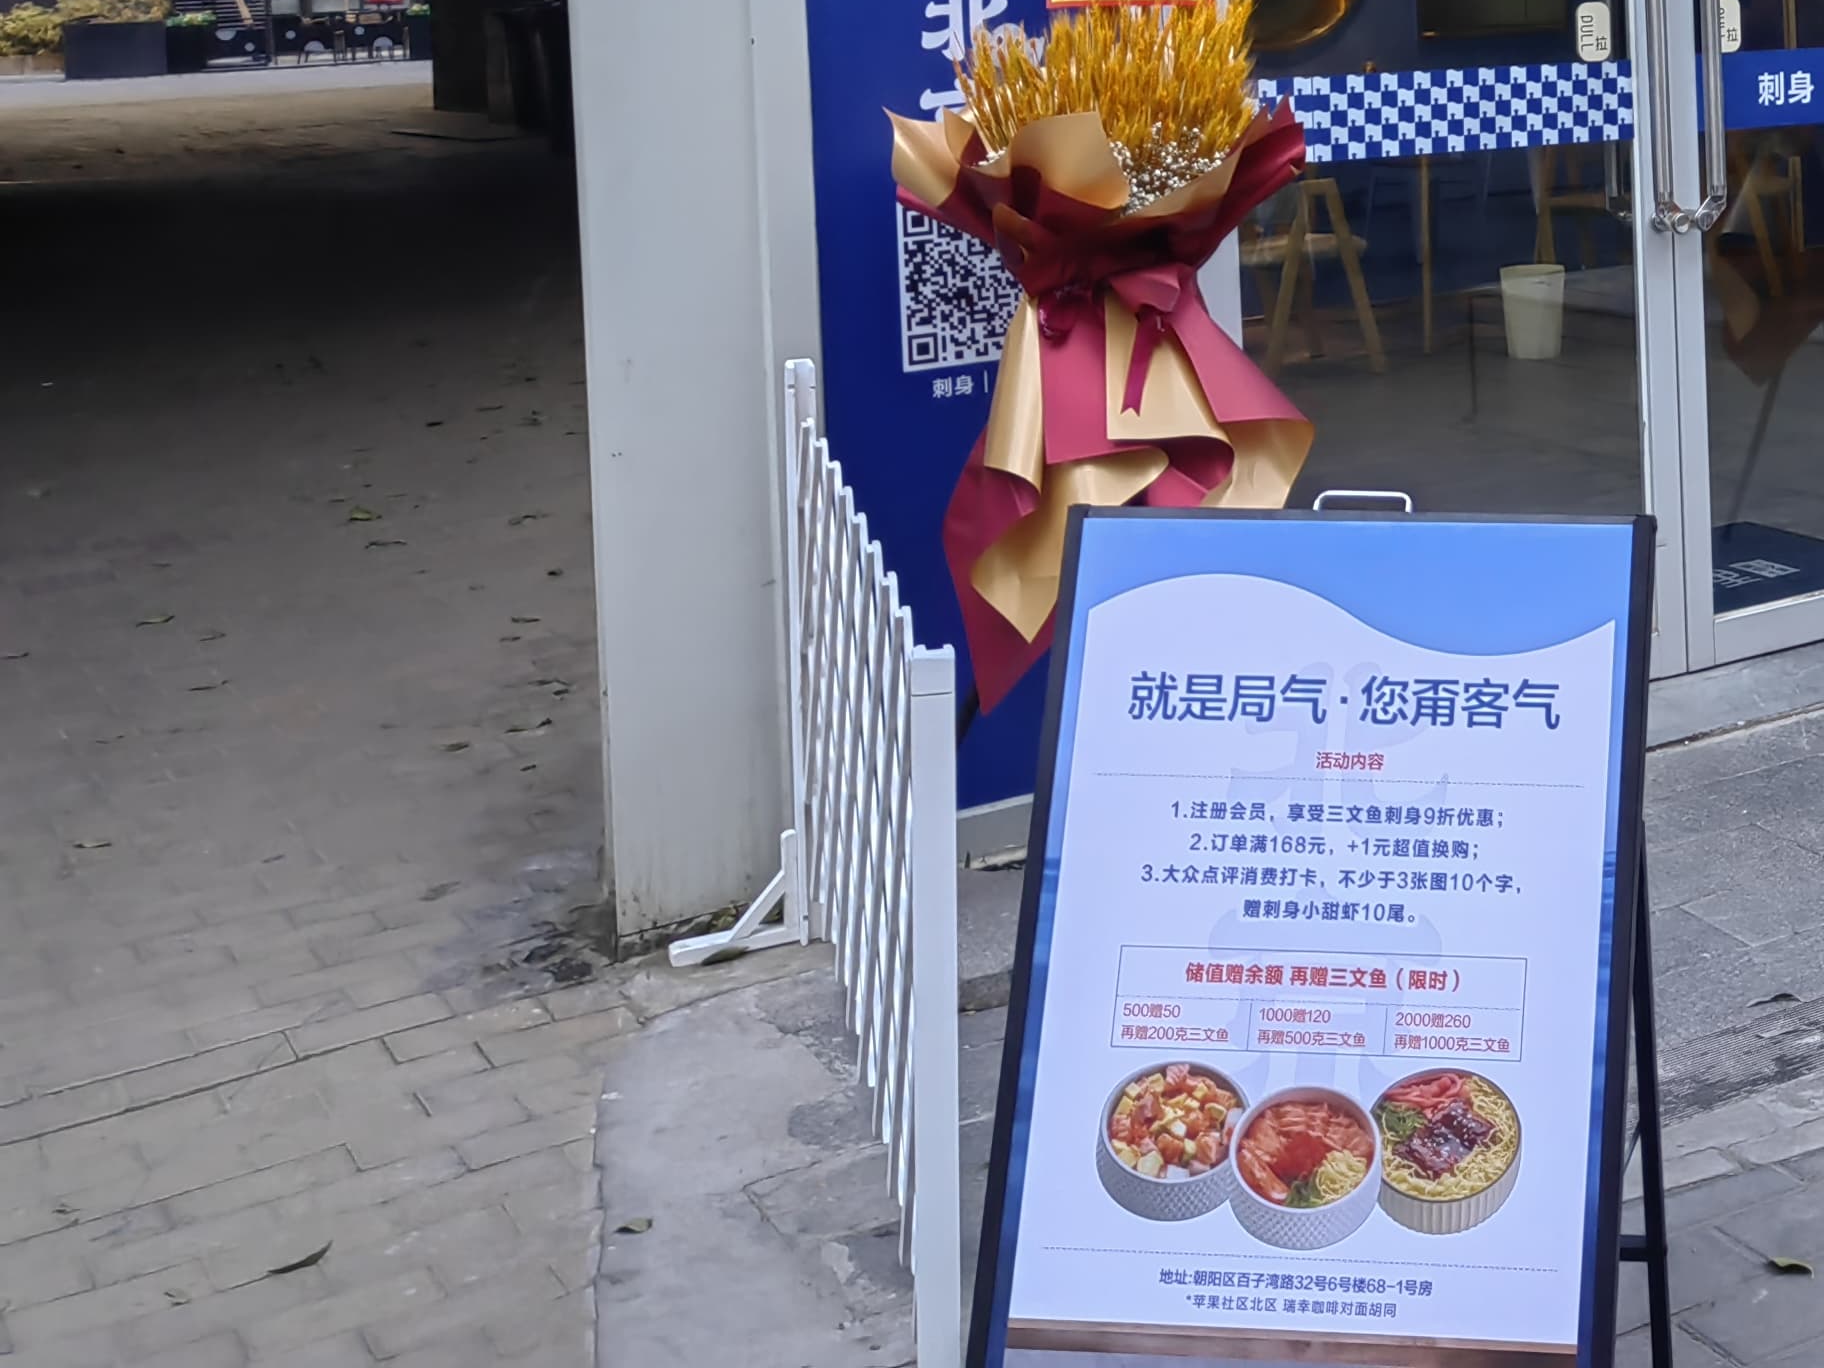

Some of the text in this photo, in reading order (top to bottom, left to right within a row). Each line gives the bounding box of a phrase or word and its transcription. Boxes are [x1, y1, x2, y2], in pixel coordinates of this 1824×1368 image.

[1726, 27, 1738, 42] 拉
[1595, 36, 1608, 52] 拉
[1316, 751, 1385, 771] 活动内容
[1243, 899, 1415, 923] 赠刺身小甜虾10尾。
[1123, 1003, 1181, 1018] 500赠50
[1259, 1008, 1331, 1023] 1000赠120
[1395, 1012, 1471, 1029] 2000赠260
[1121, 1024, 1229, 1042] 再赠200克三文鱼
[1257, 1029, 1366, 1047] 再赠500克三文鱼
[1394, 1034, 1510, 1053] 再赠1000克三文鱼
